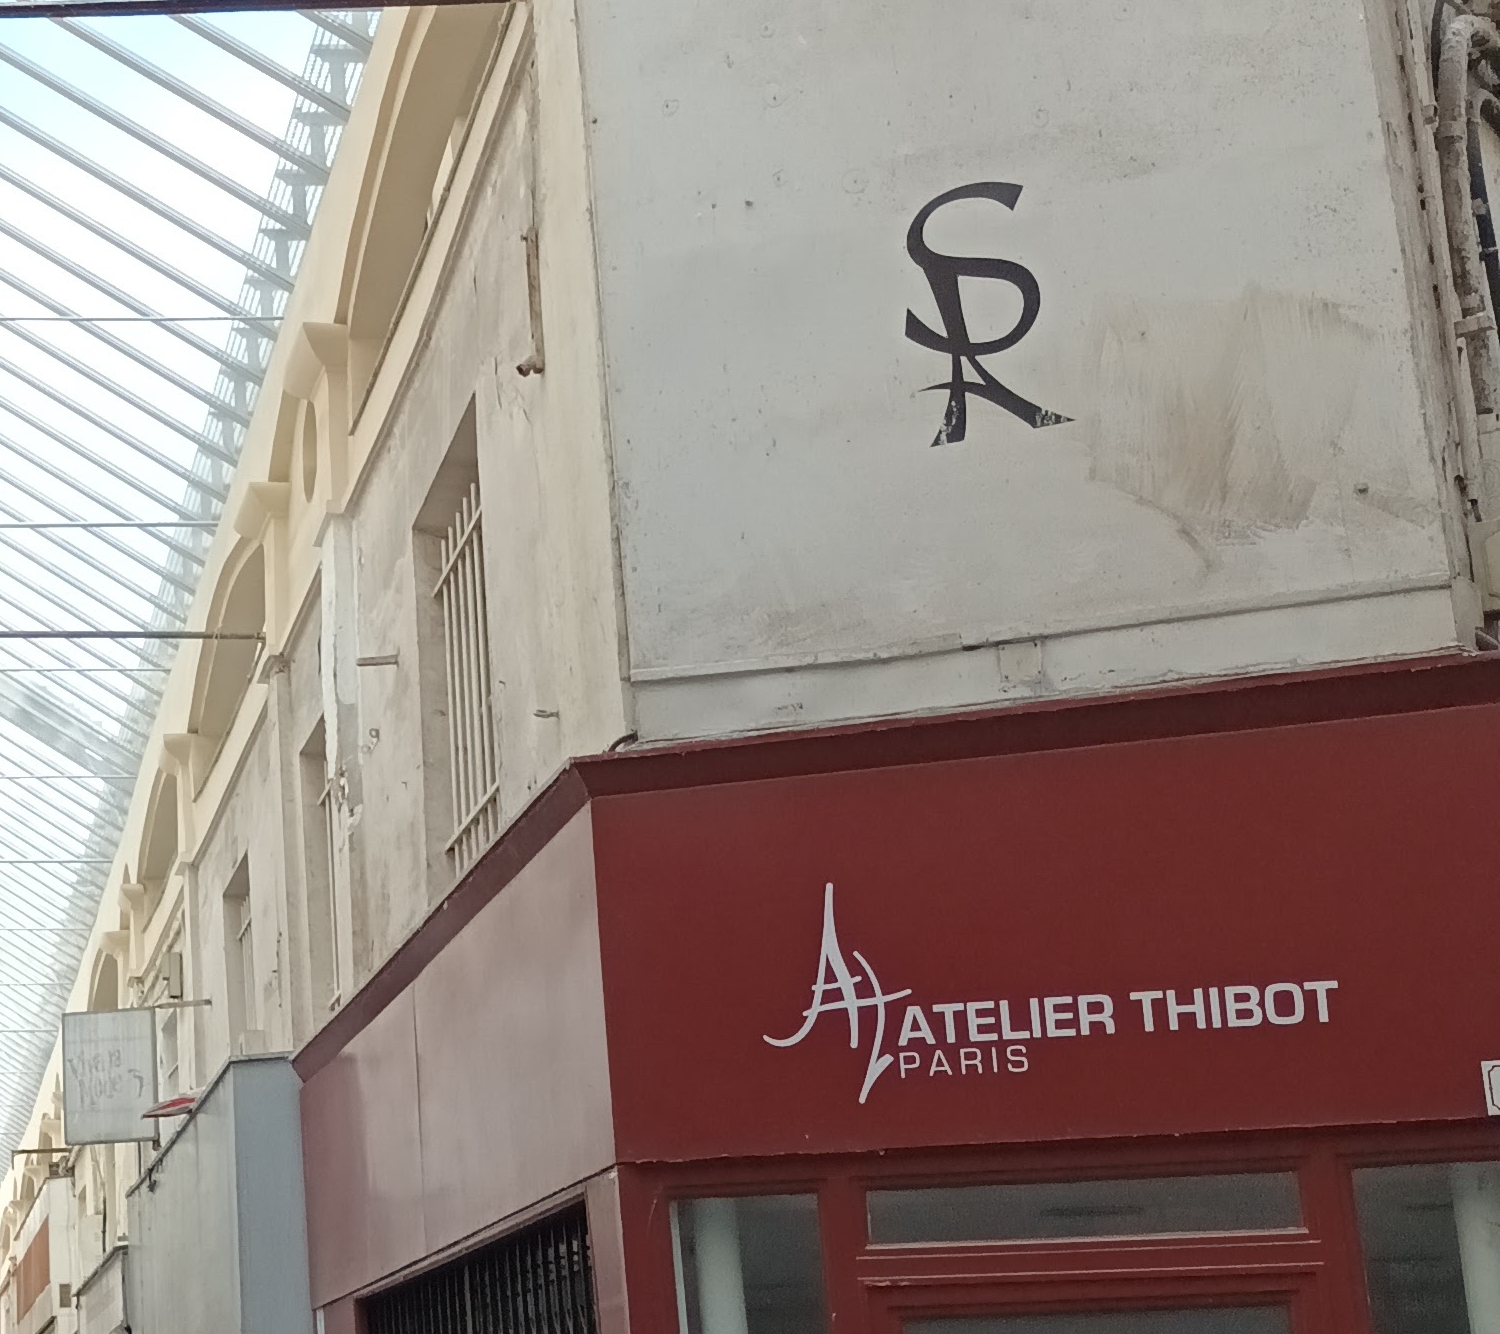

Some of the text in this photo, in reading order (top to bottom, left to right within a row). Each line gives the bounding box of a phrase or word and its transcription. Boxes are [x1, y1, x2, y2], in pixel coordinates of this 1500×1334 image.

[898, 980, 1339, 1047] ATELIER THIBOT
[900, 1045, 1030, 1079] PARIS
